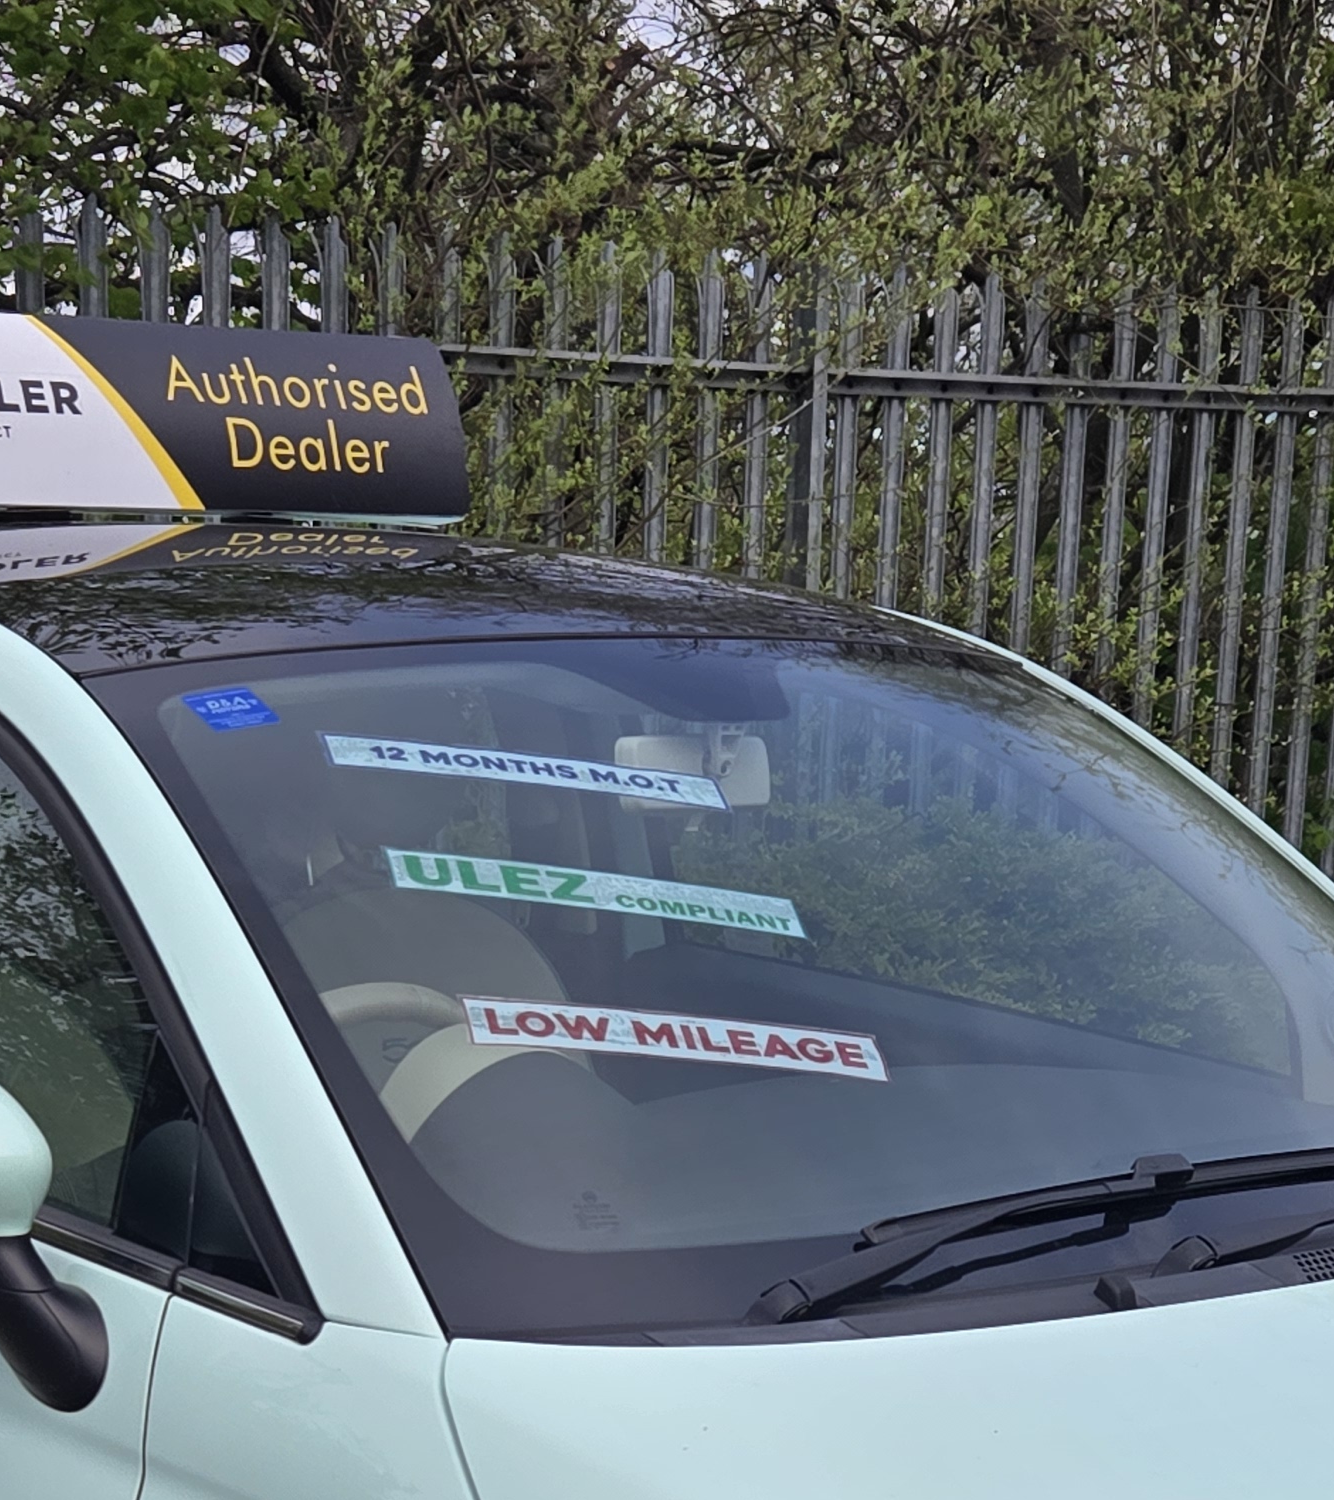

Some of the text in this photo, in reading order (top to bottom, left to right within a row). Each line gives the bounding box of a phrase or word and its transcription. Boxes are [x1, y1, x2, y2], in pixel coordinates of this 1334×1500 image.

[167, 354, 429, 416] Authorised
[225, 416, 390, 474] Dealer
[369, 745, 681, 794] 12 MONTHS M.O.T
[402, 853, 791, 932] ULEZ COMPLIANT
[483, 1007, 869, 1069] LOW MILEAGE
